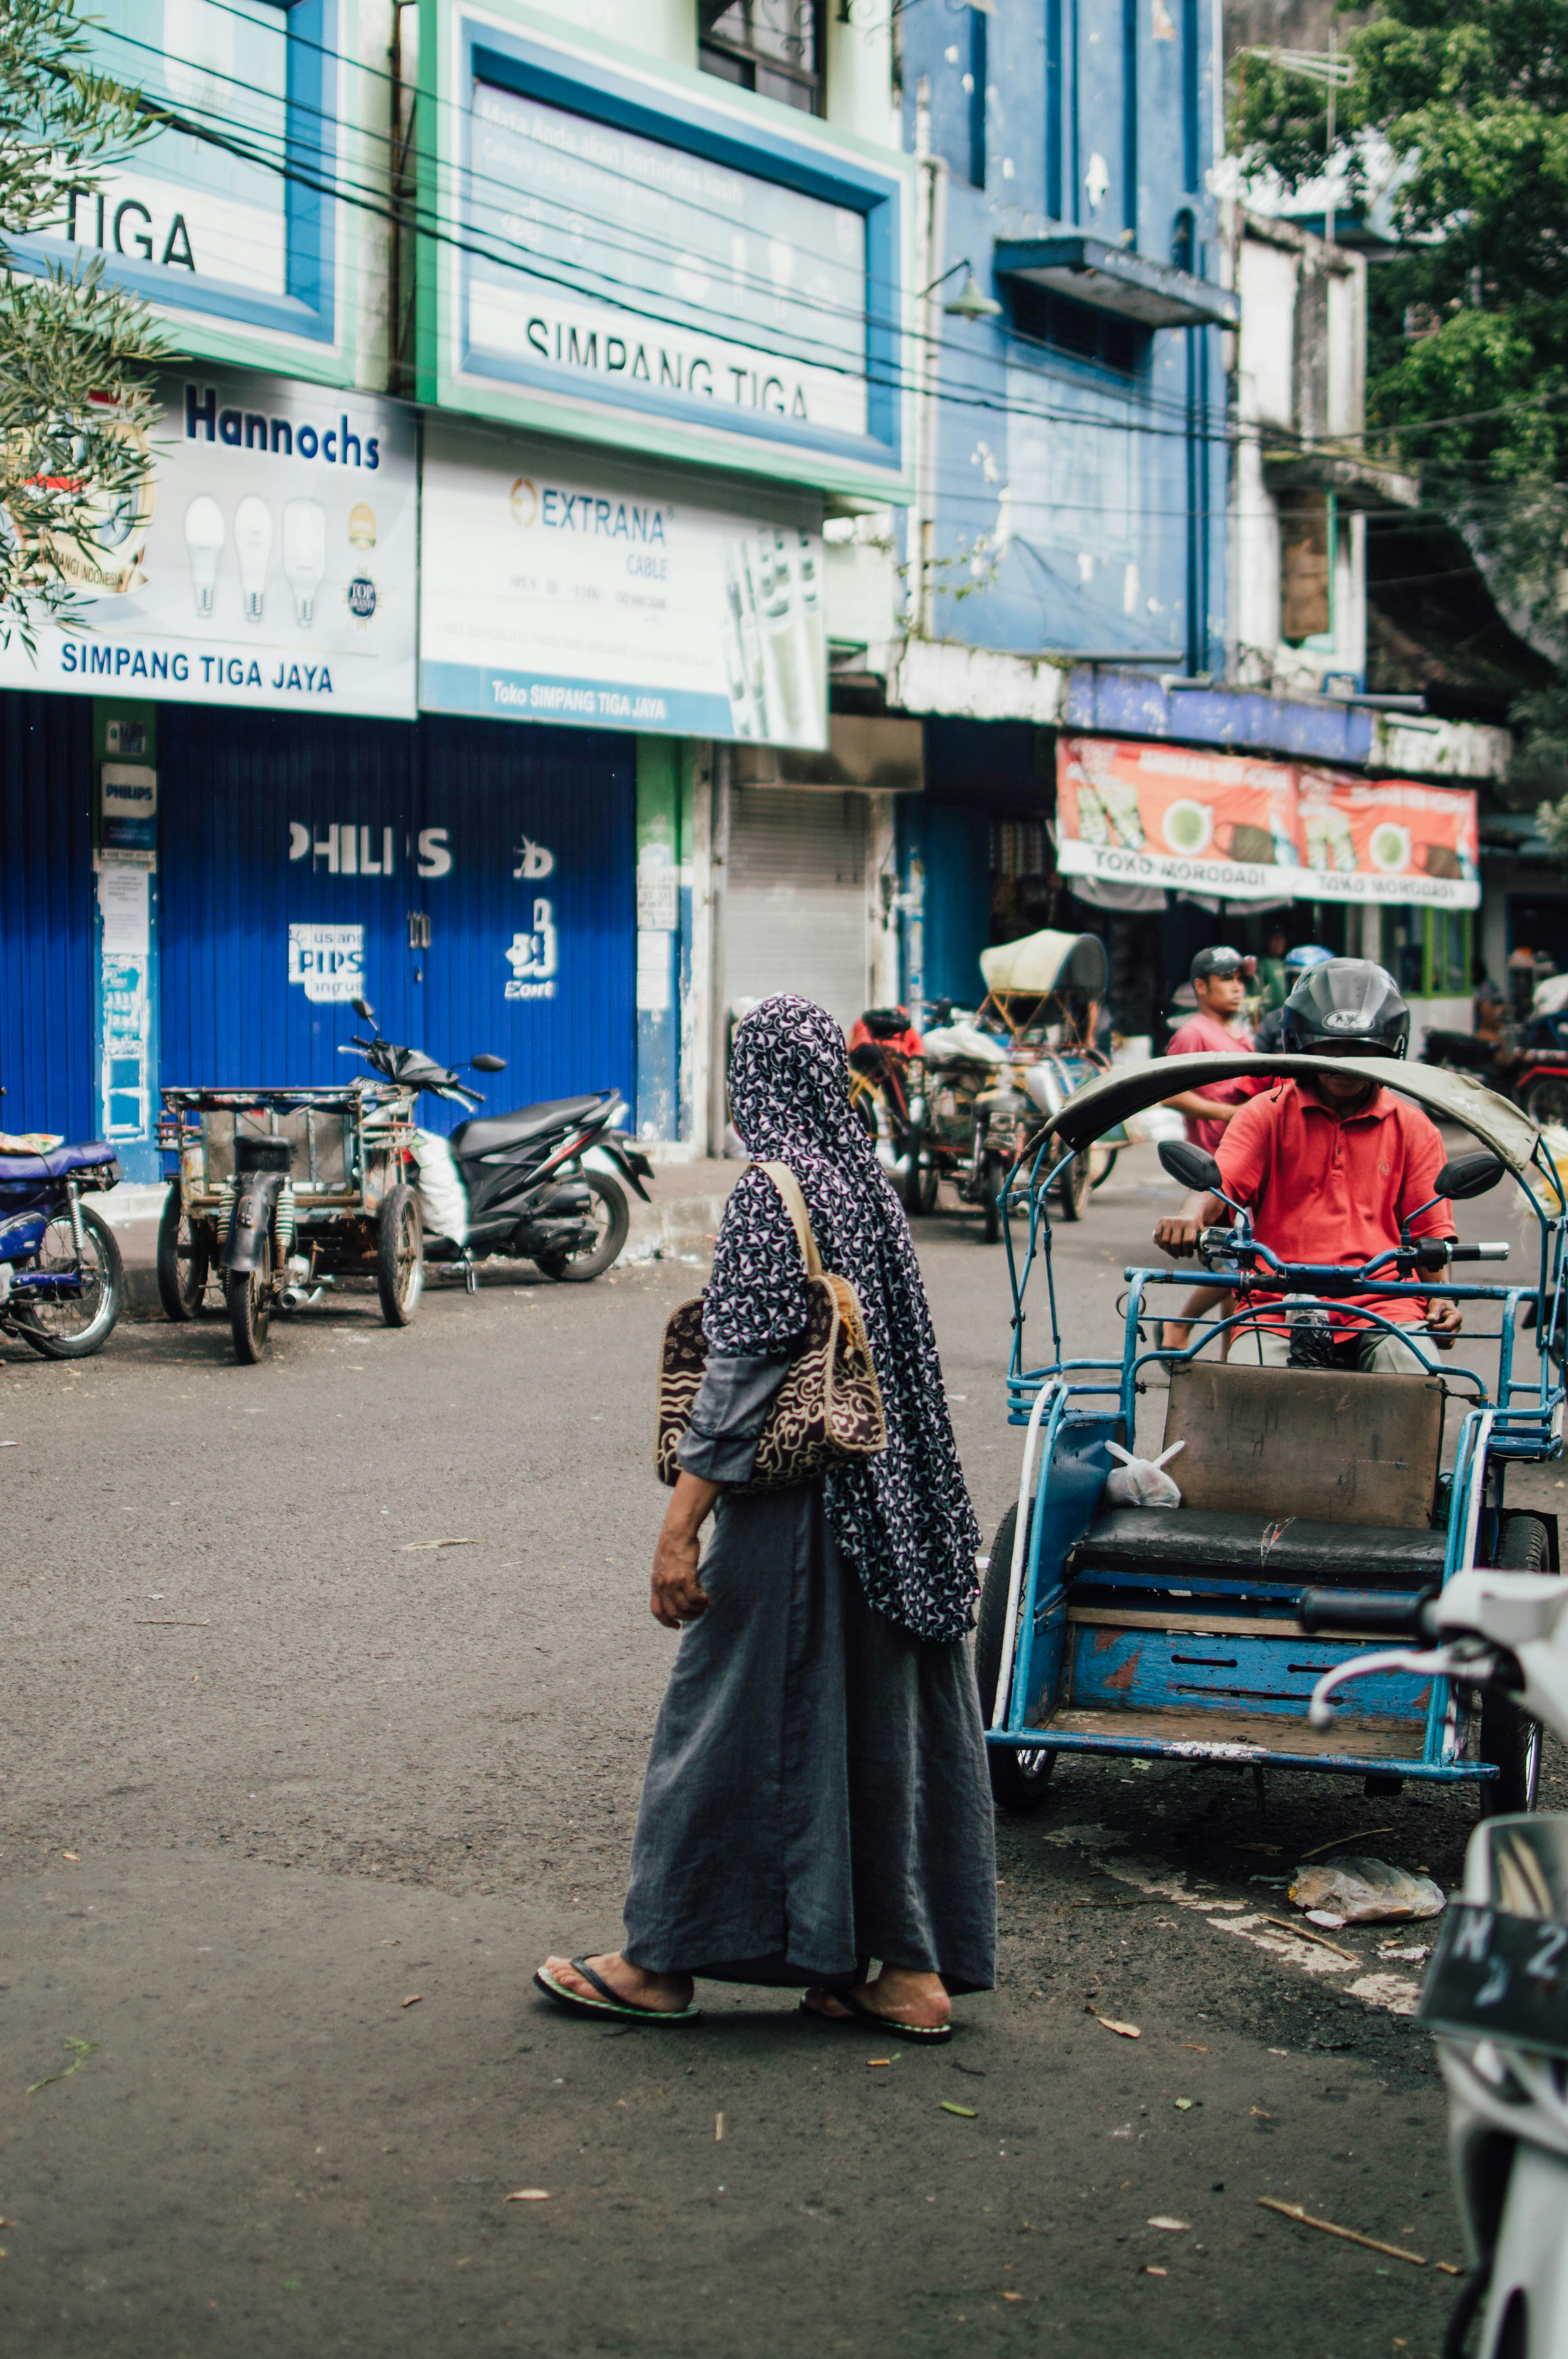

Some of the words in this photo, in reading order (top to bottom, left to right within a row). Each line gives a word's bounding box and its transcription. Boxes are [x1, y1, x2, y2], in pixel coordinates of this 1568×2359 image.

[67, 189, 196, 273] TIGA
[526, 318, 713, 398] SIMPANG
[728, 365, 808, 421] TIGA
[186, 384, 379, 470] Hannochs
[542, 489, 666, 547] EXTRANA
[80, 564, 123, 586] INDONESIA
[627, 553, 666, 580] CABLE
[353, 583, 372, 599] TOP
[62, 643, 189, 681] SIMPANG
[201, 655, 261, 687] TIGA
[273, 665, 333, 693] JAYA
[492, 680, 526, 705] Toko
[530, 685, 595, 713] SIMPANG
[597, 692, 630, 716] TIGA
[633, 695, 666, 720] JAYA
[106, 784, 152, 801] PHILIPS
[1092, 848, 1152, 878] TOKO
[1160, 858, 1267, 887] MORODADI
[1318, 874, 1365, 894] TOKO
